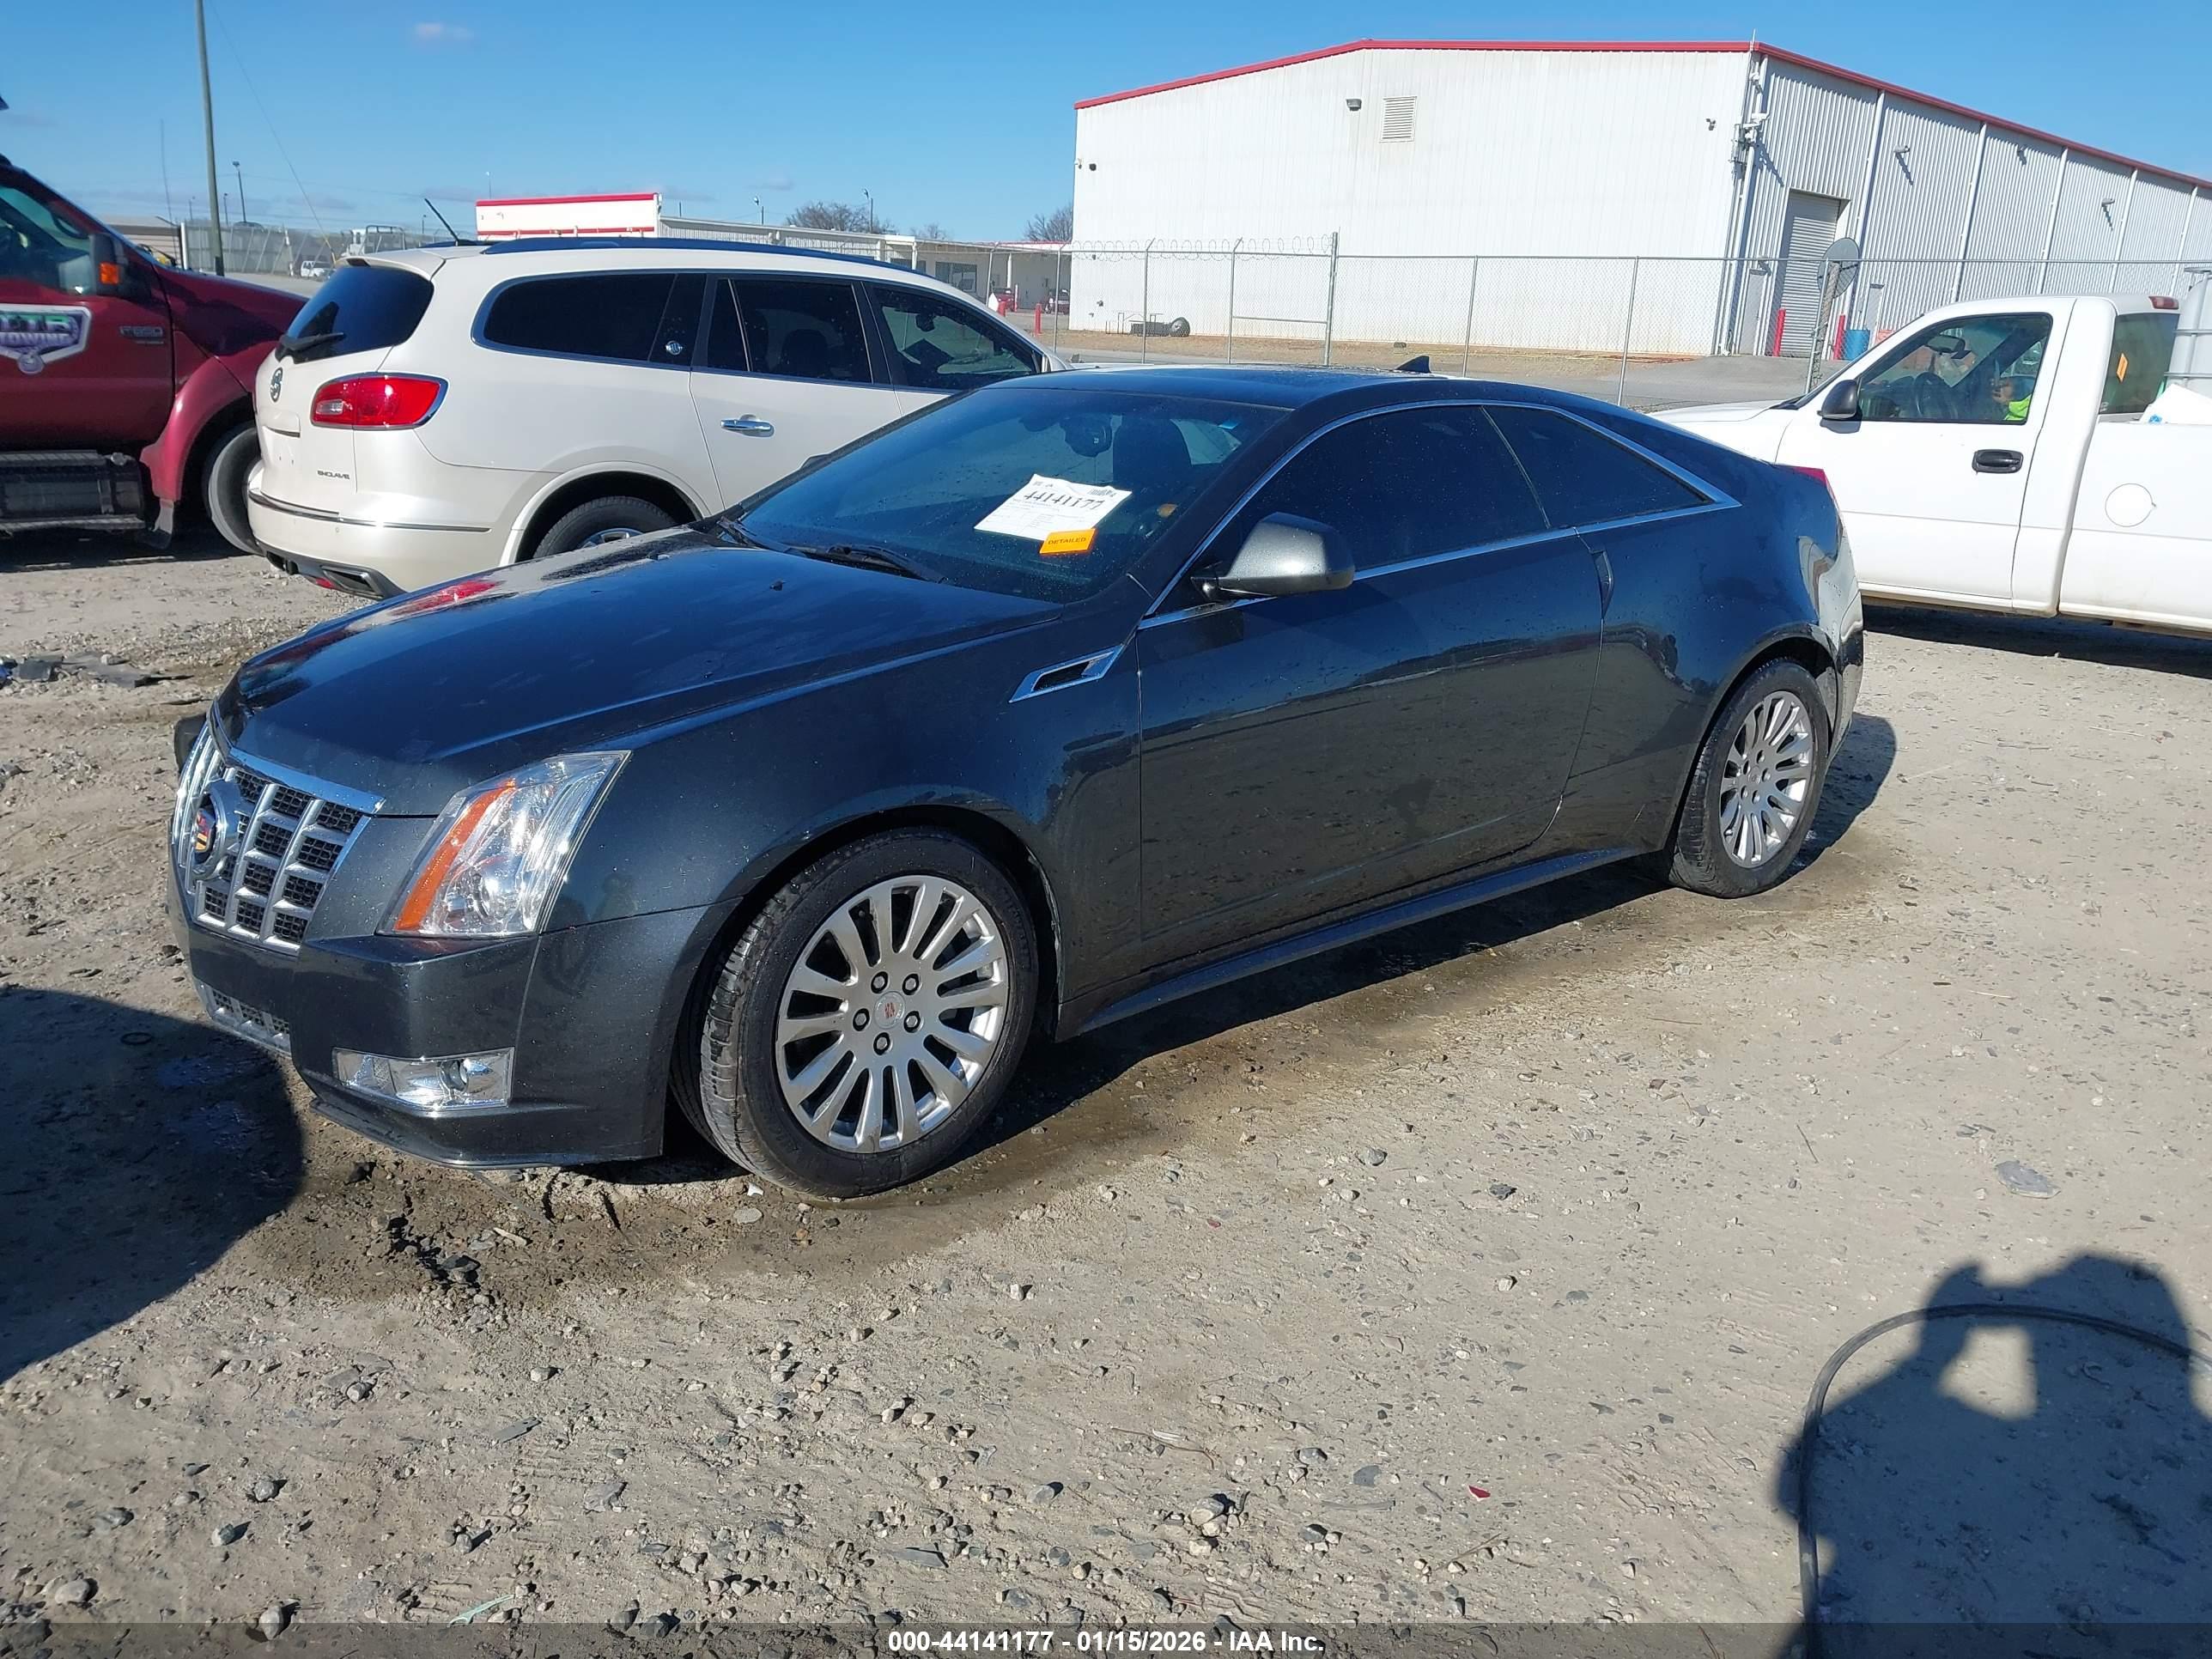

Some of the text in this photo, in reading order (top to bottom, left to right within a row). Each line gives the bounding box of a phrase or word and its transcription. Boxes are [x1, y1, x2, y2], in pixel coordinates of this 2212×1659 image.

[317, 470, 350, 480] ENCLAVE
[1024, 490, 1105, 510] 44141177
[1048, 537, 1087, 545] DETAILED
